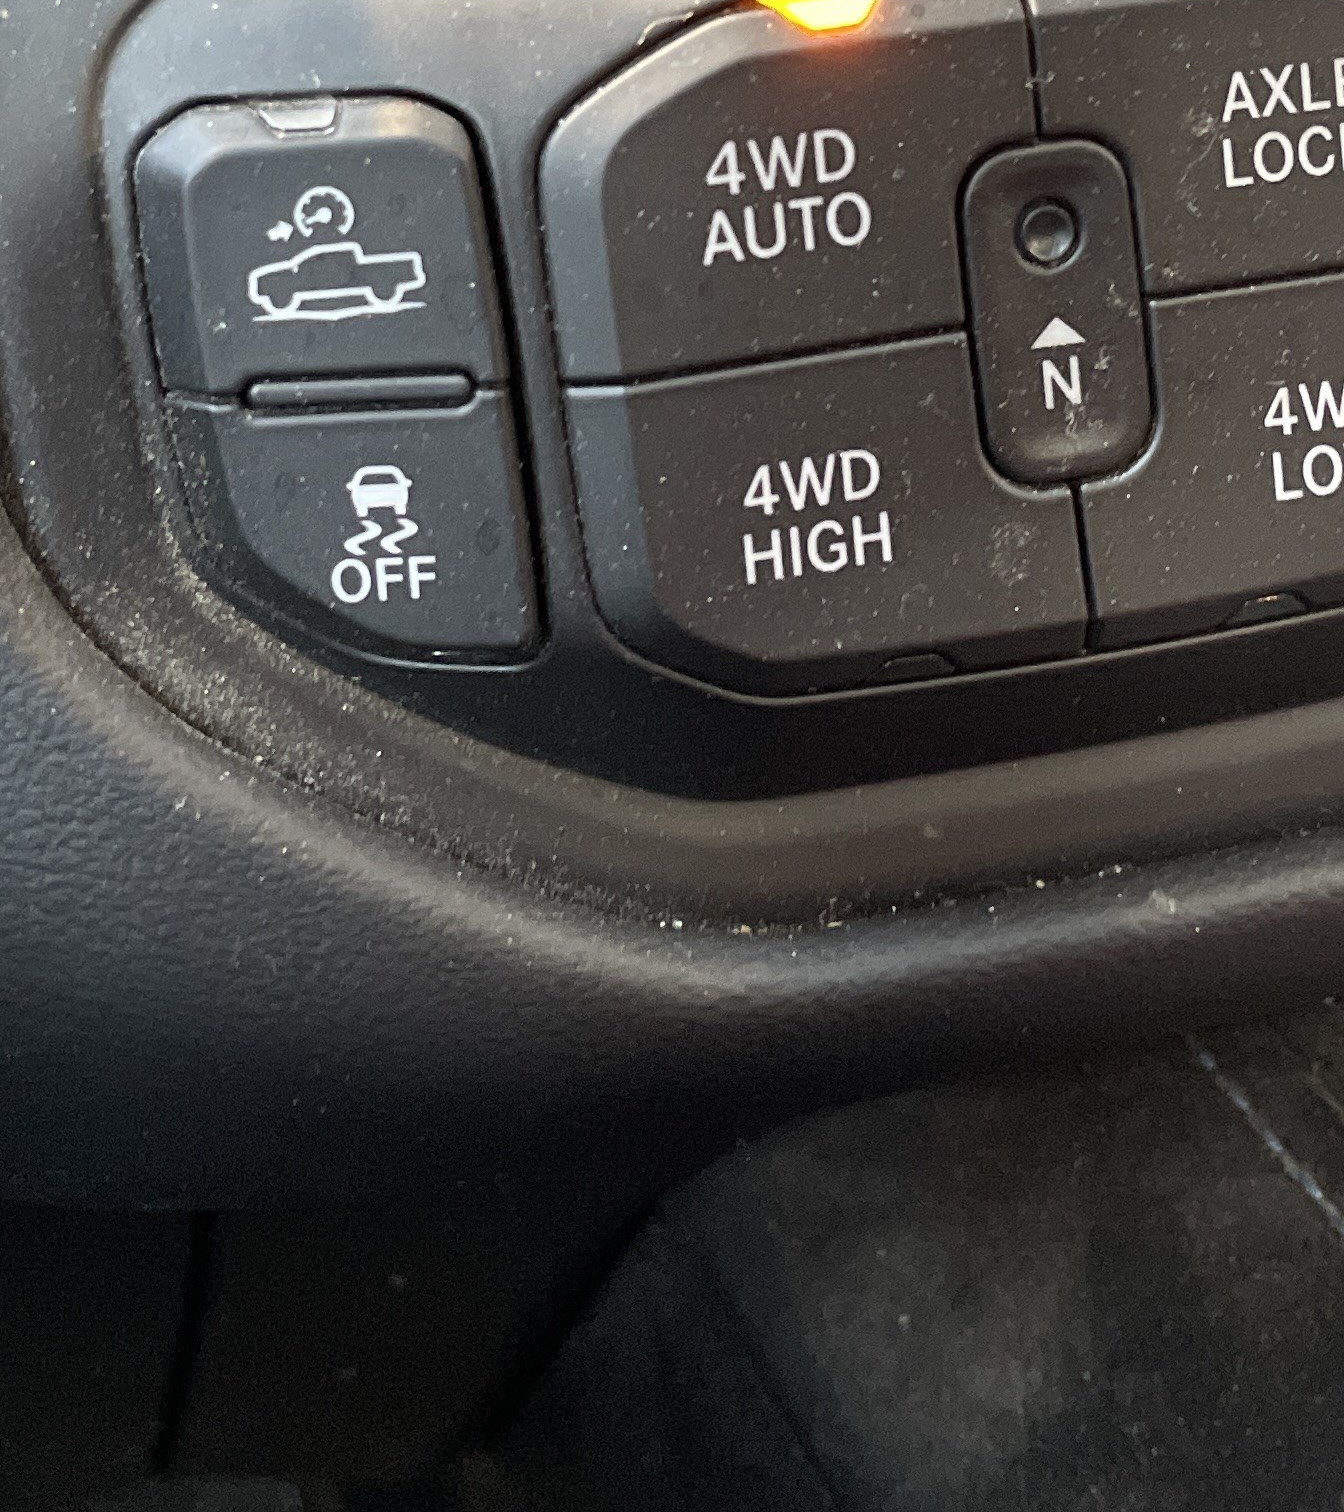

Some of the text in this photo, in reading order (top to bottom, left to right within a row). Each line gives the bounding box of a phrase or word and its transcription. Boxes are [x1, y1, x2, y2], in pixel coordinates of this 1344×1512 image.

[706, 129, 856, 196] 4WD
[701, 192, 873, 267] AUTO
[1041, 356, 1083, 410] N
[743, 450, 882, 517] 4WD
[330, 555, 437, 604] OFF
[742, 511, 894, 584] HIGH
